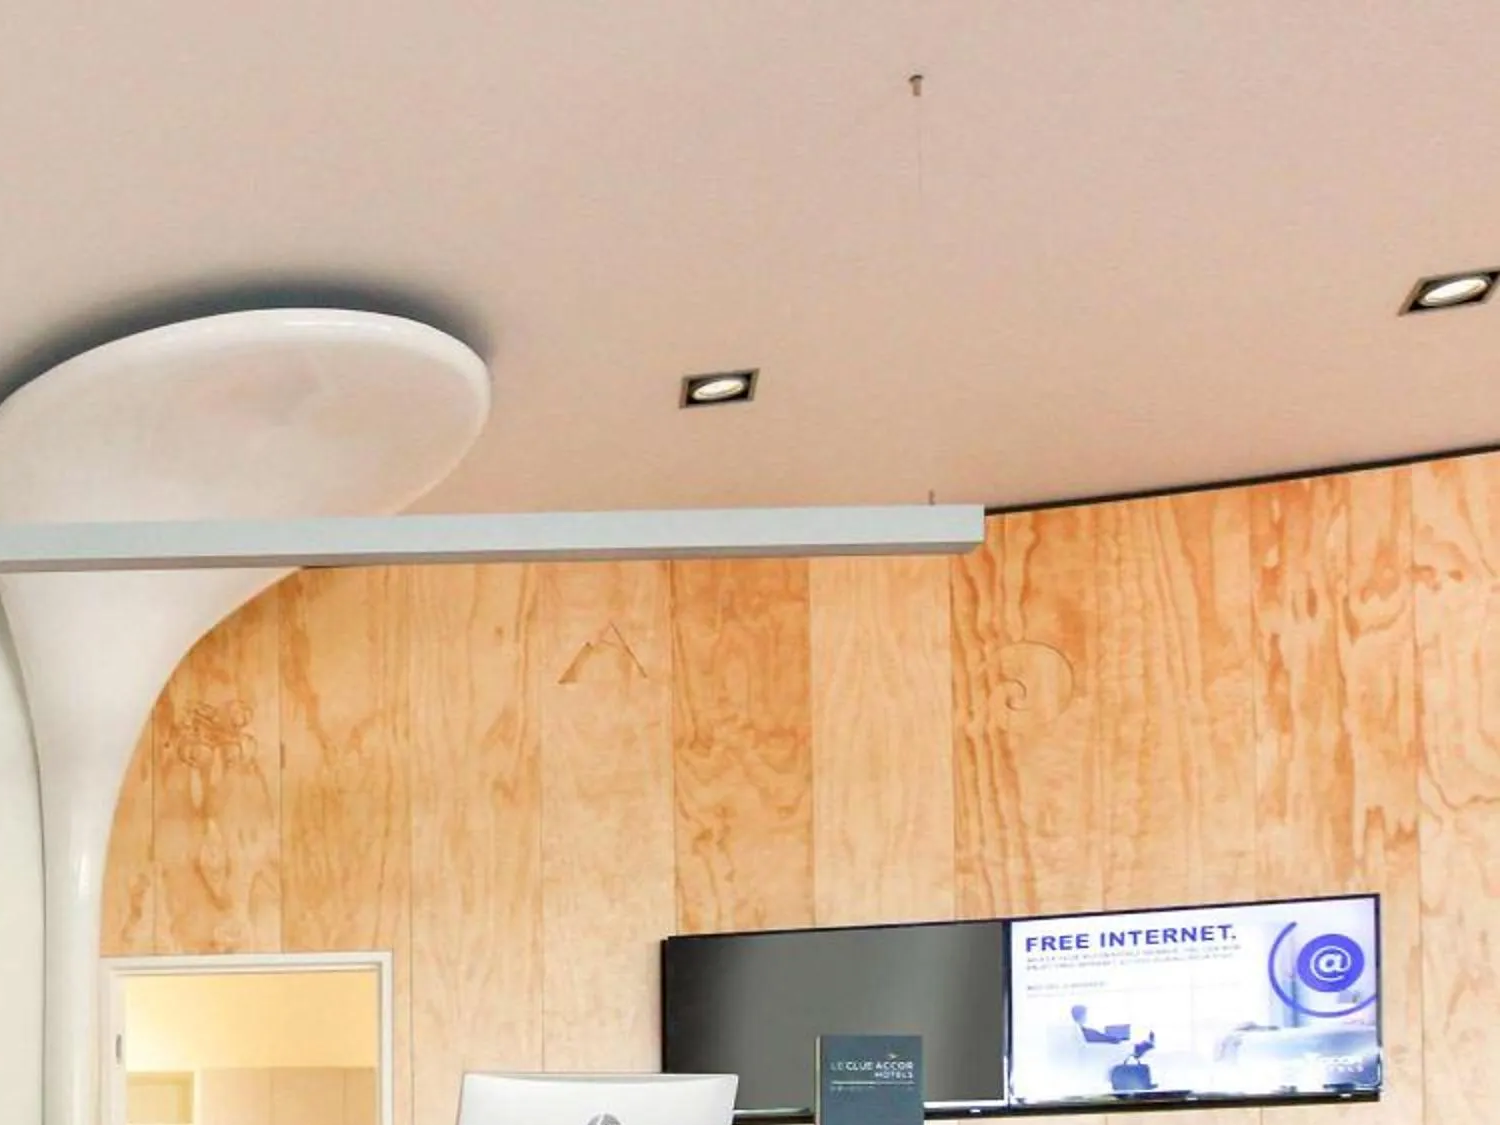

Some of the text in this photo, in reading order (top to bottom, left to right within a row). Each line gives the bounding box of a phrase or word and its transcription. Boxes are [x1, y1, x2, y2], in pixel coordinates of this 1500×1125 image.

[1026, 925, 1236, 952] FREE INTERNET.
[875, 1061, 913, 1070] ACCOR
[874, 1071, 913, 1079] HOTELS
